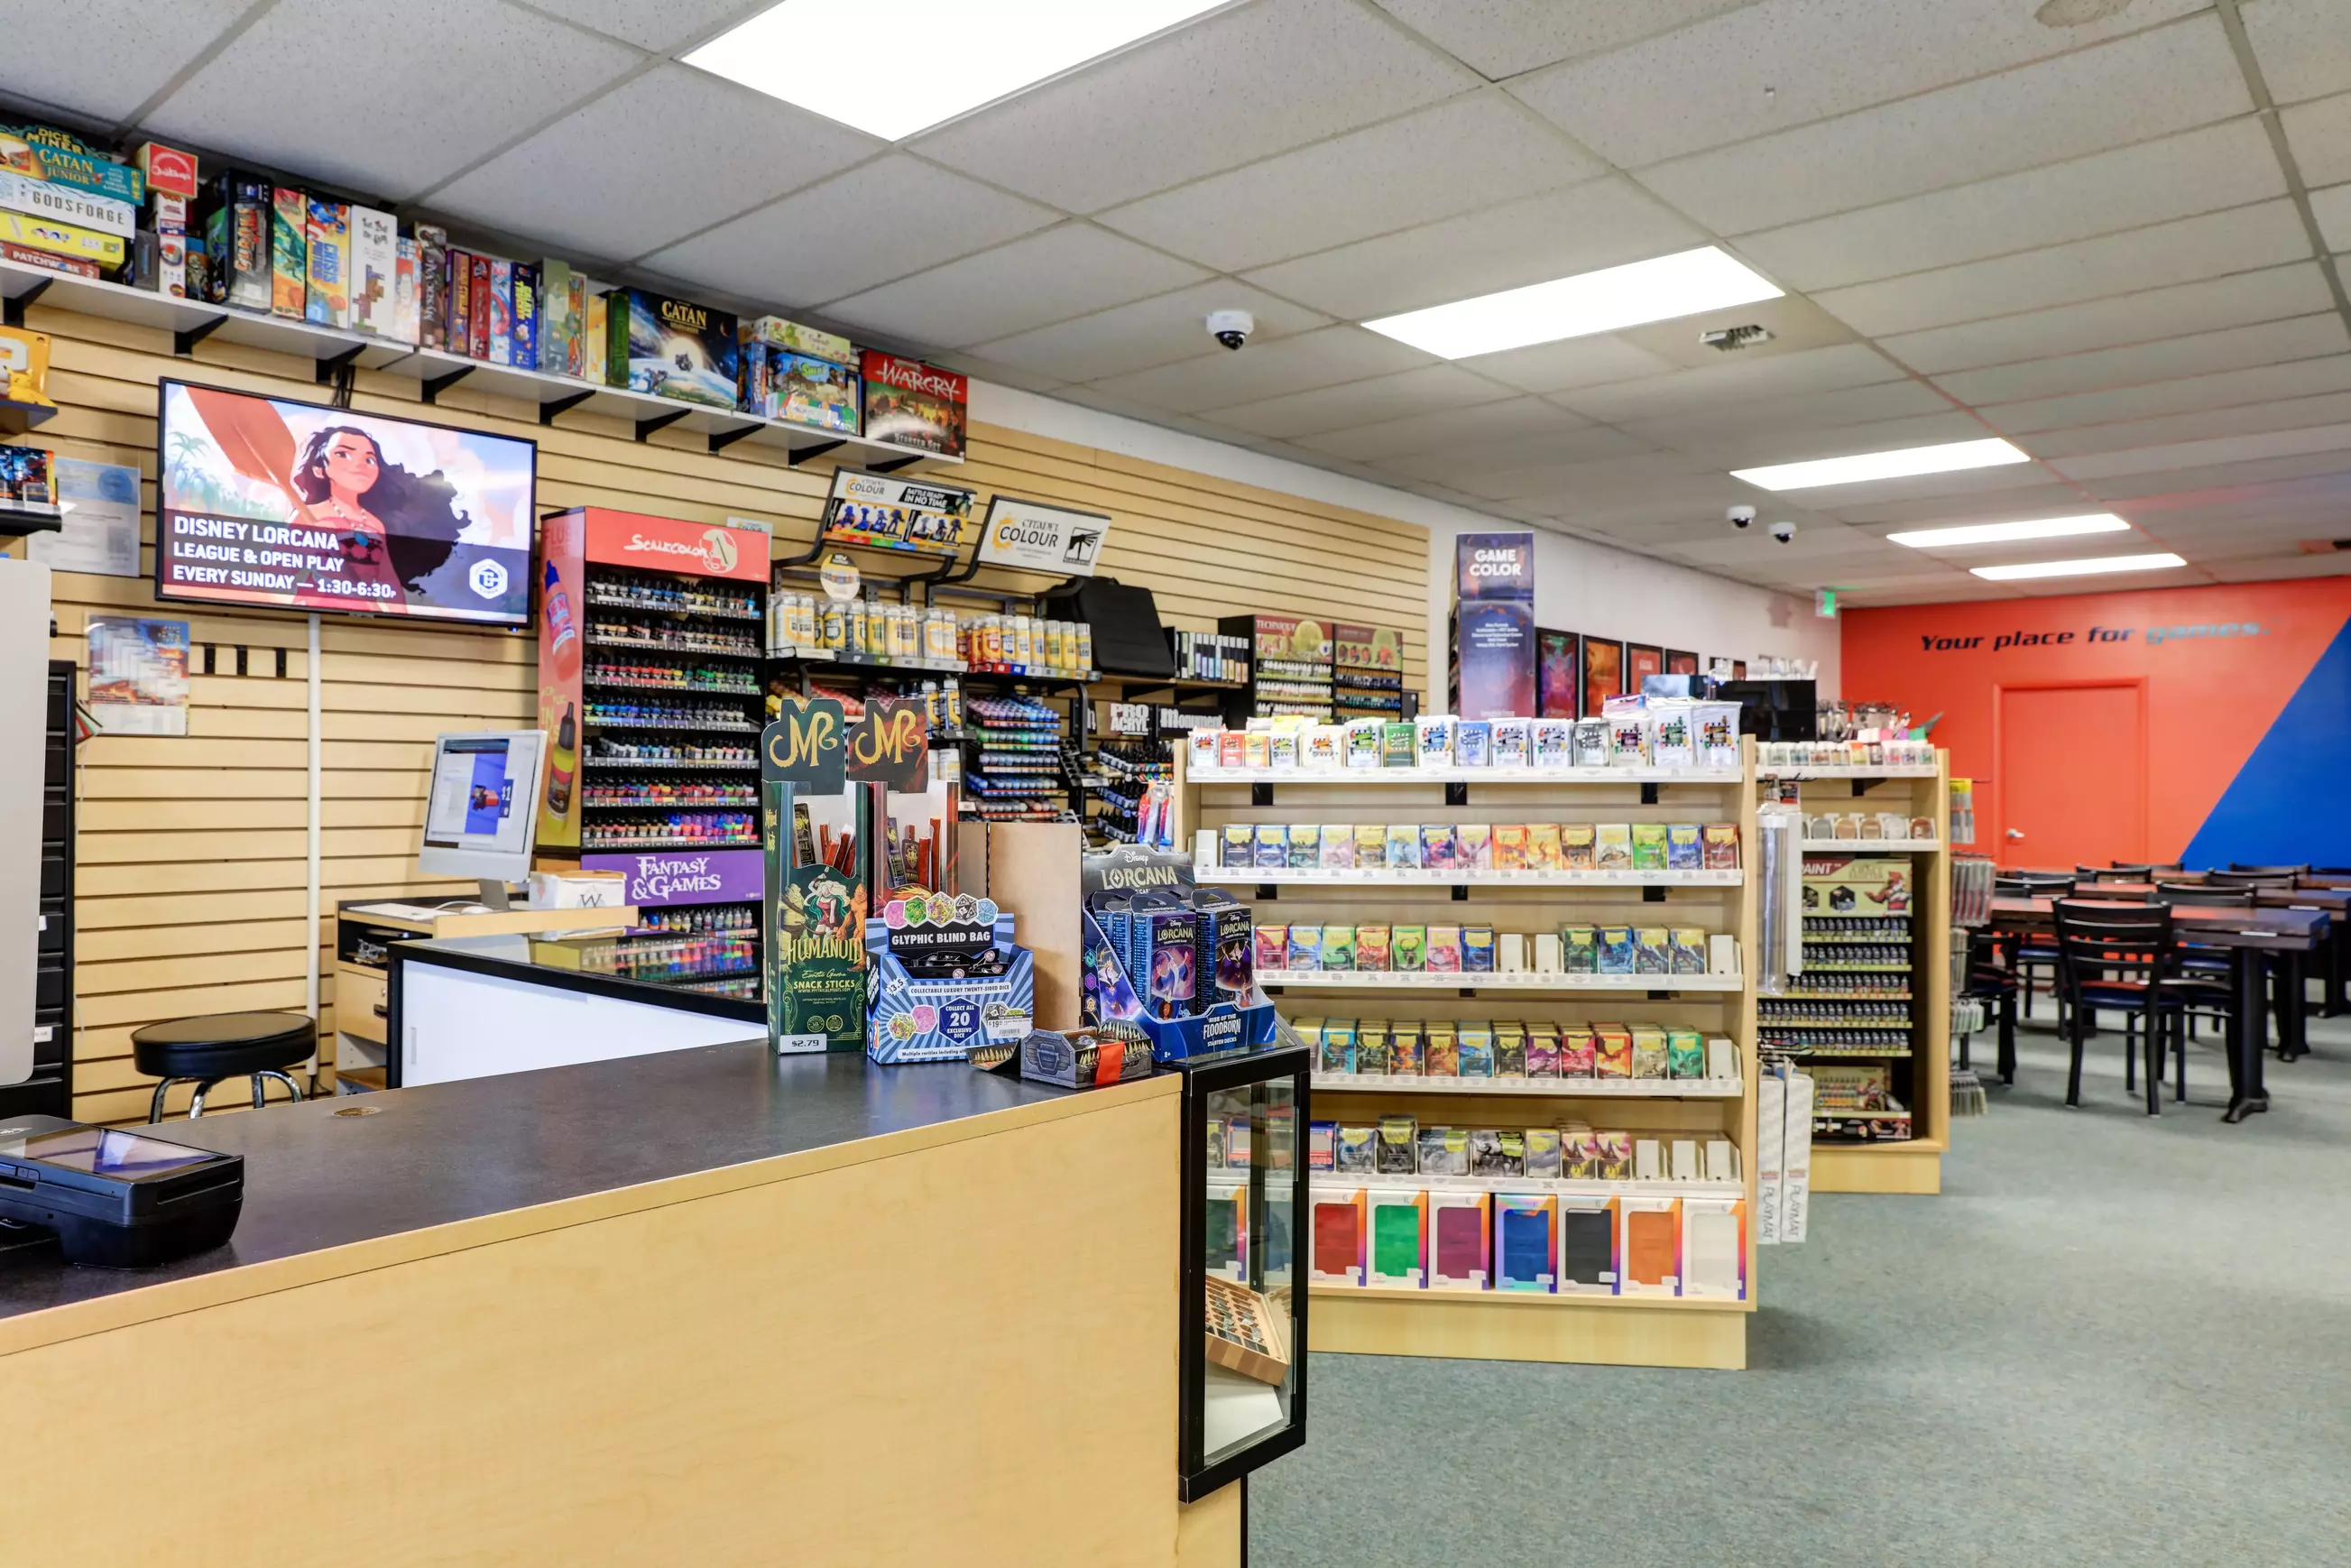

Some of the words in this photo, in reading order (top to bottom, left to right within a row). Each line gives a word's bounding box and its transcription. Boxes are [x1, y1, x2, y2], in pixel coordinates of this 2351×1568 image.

[26, 133, 83, 154] MINER
[37, 127, 72, 143] DICE
[39, 149, 94, 172] CATAN
[47, 166, 90, 185] JUNIOR
[32, 190, 124, 225] GODSFORGE
[661, 300, 707, 327] CATAN
[875, 360, 961, 401] WARCRY
[849, 482, 885, 495] COLOUR
[913, 496, 928, 505] NO
[927, 498, 948, 508] TIME
[174, 516, 249, 540] DISNEY
[252, 526, 340, 551] LORCANA
[1000, 526, 1058, 548] COLOUR
[173, 541, 240, 563] LEAGUE
[243, 549, 258, 565] &
[260, 550, 303, 569] OPEN
[306, 556, 345, 573] PLAY
[1474, 549, 1517, 563] GAME
[172, 565, 229, 585] EVERY
[231, 570, 296, 590] SUNDAY
[1469, 563, 1522, 577] COLOR
[1921, 634, 1985, 651] Your
[1993, 630, 2075, 652] place
[2087, 626, 2135, 644] for
[1110, 704, 1149, 718] PRO
[1111, 716, 1149, 732] ACRYL
[1121, 850, 1149, 865] Disney
[635, 856, 710, 881] FANTASY
[1101, 866, 1178, 890] LORCANA
[891, 935, 934, 945] GLYPHIC
[936, 933, 967, 944] BLIND
[971, 931, 991, 942] BAG
[1157, 927, 1194, 941] LORCANA
[1220, 921, 1250, 936] LORCANA
[787, 938, 863, 965] HUMANOID
[794, 981, 822, 989] SNACK
[825, 980, 855, 988] STICKS
[950, 1012, 970, 1027] 20
[1203, 1019, 1241, 1039] FLOODBORN
[791, 1039, 819, 1047] $2.79
[1763, 1186, 1775, 1239] PLAYMAT
[1789, 1185, 1802, 1237] PLAYMAT
